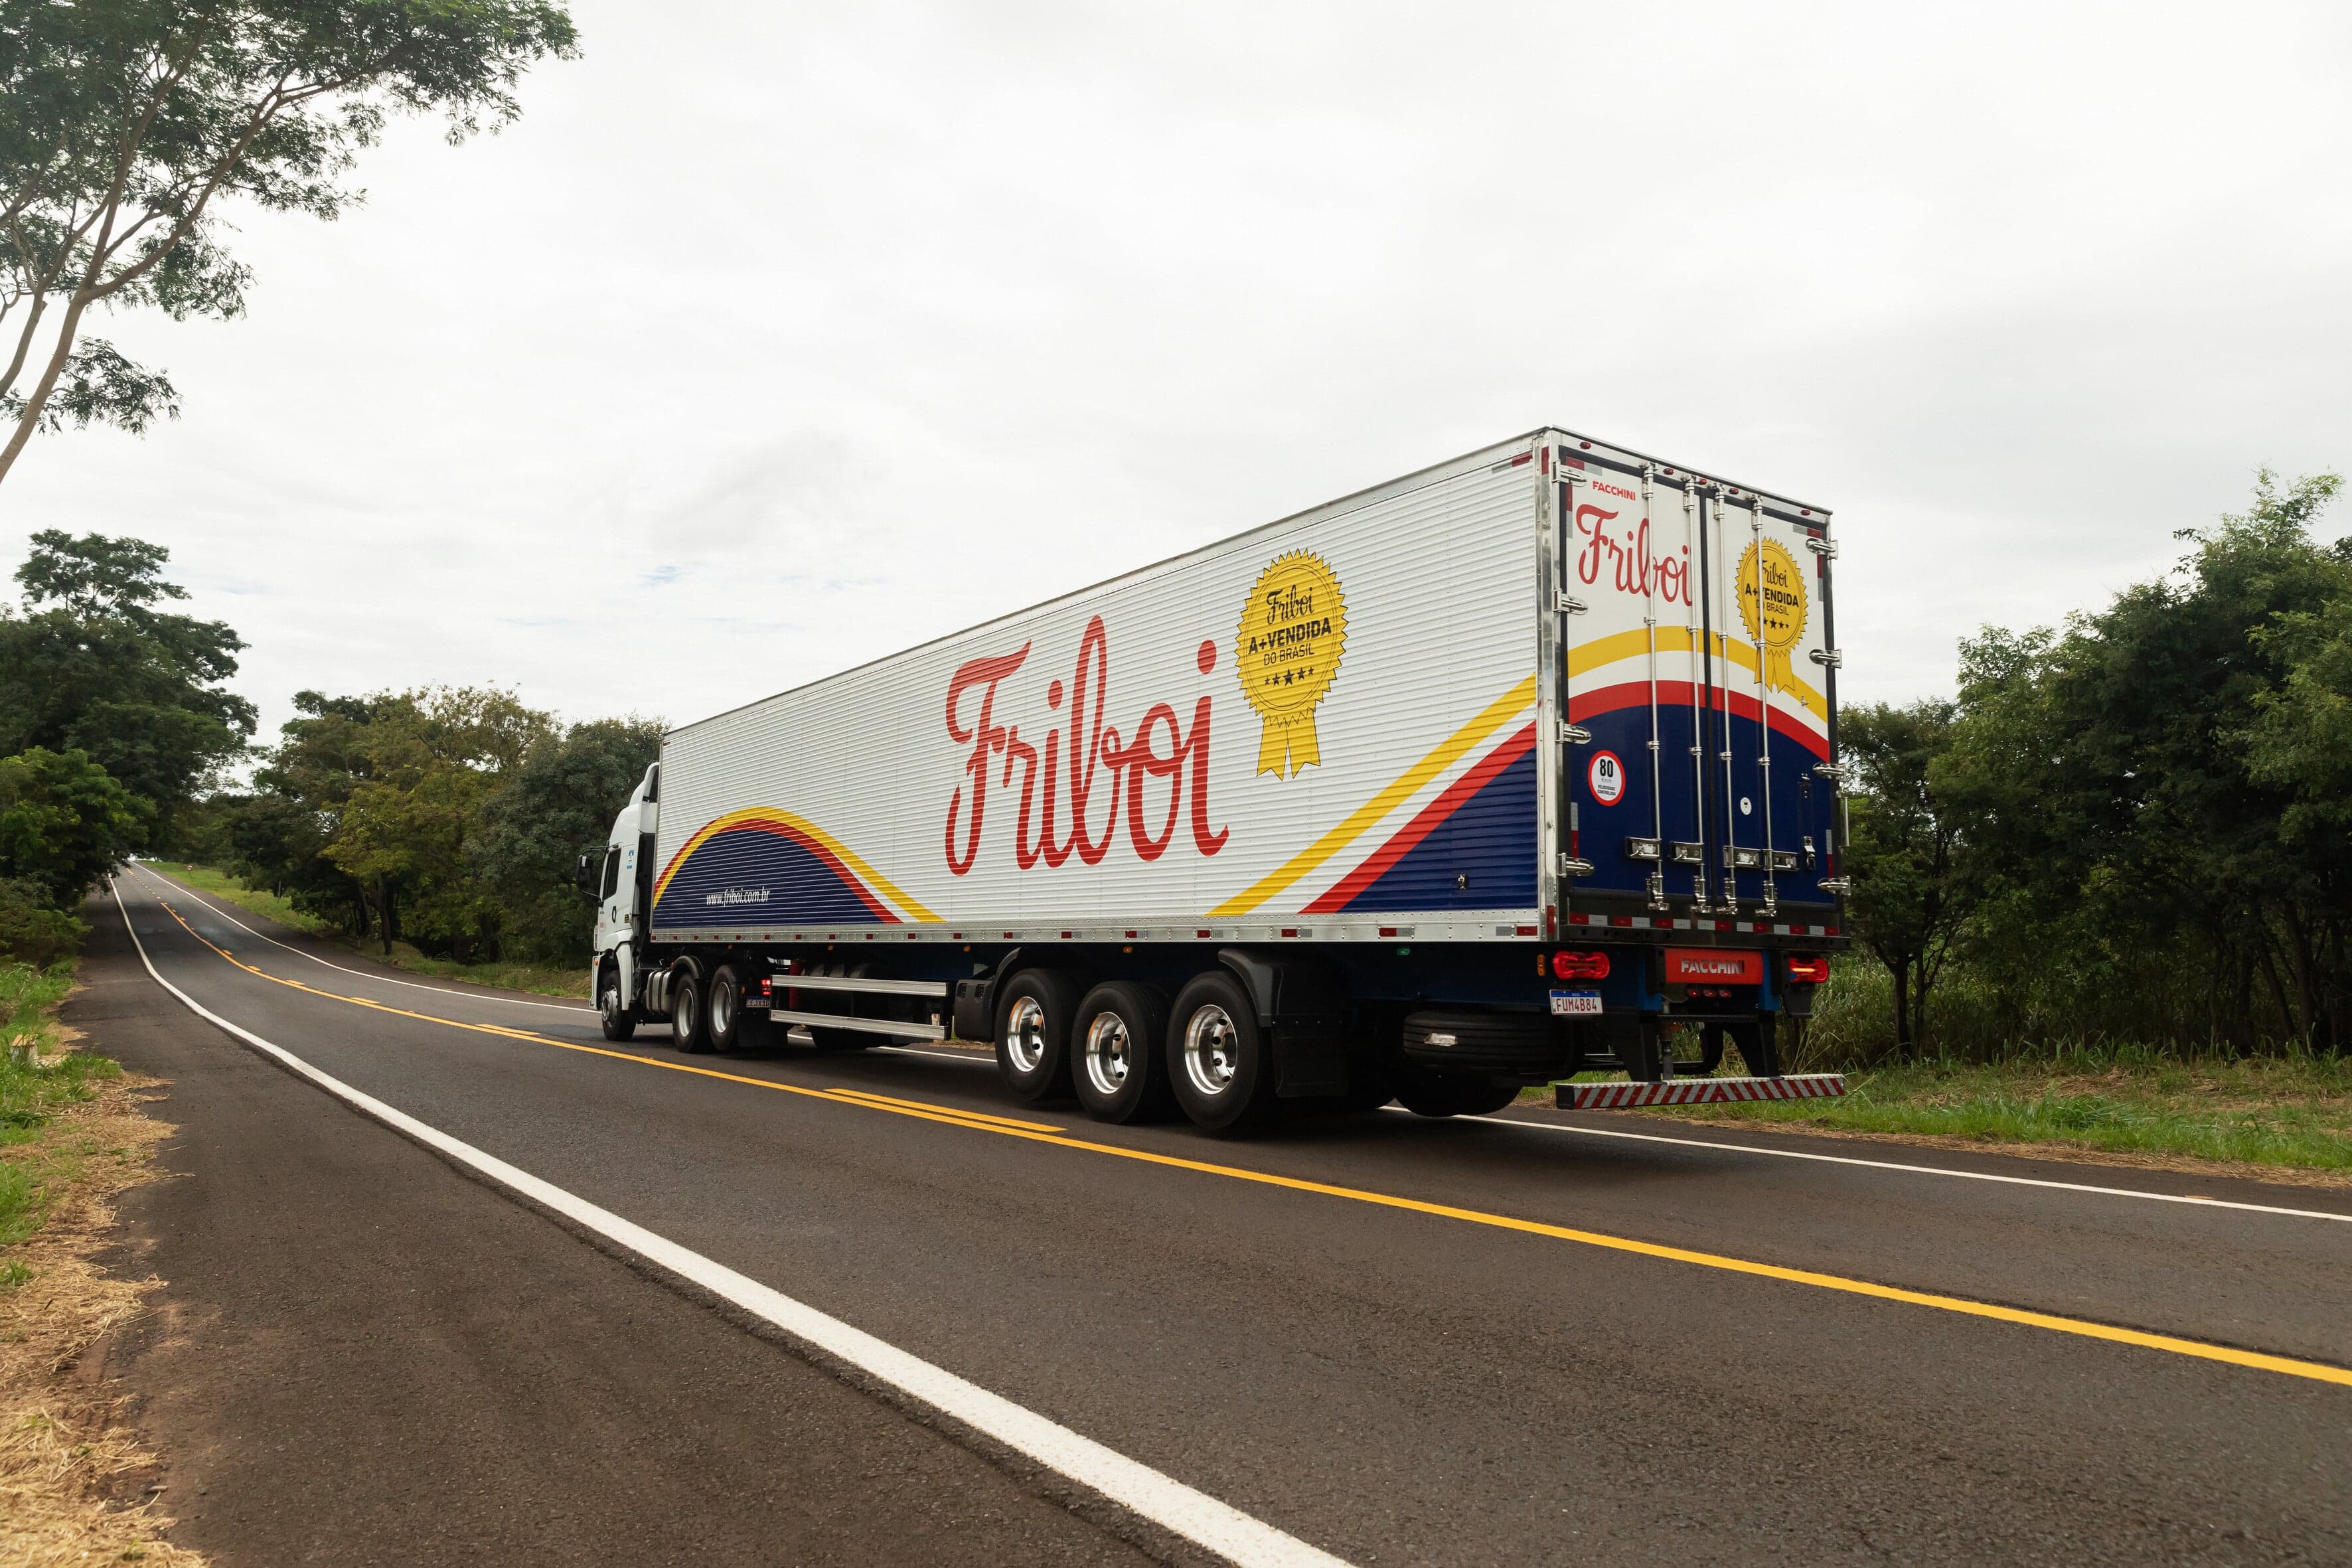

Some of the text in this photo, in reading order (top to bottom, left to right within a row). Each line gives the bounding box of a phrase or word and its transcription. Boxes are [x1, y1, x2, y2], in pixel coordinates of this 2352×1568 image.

[1593, 481, 1636, 501] FACCHINI
[1576, 503, 1693, 607] Friboi
[1266, 584, 1314, 625] Friboi
[1766, 602, 1789, 615] BRASIL
[1248, 617, 1332, 655] A+VENDIDA
[1264, 643, 1314, 666] DO BRASIL
[945, 615, 1229, 876] Friboi
[1600, 759, 1613, 777] 80
[706, 886, 771, 907] www.friboi.com.br
[1556, 998, 1597, 1012] FUM4B84
